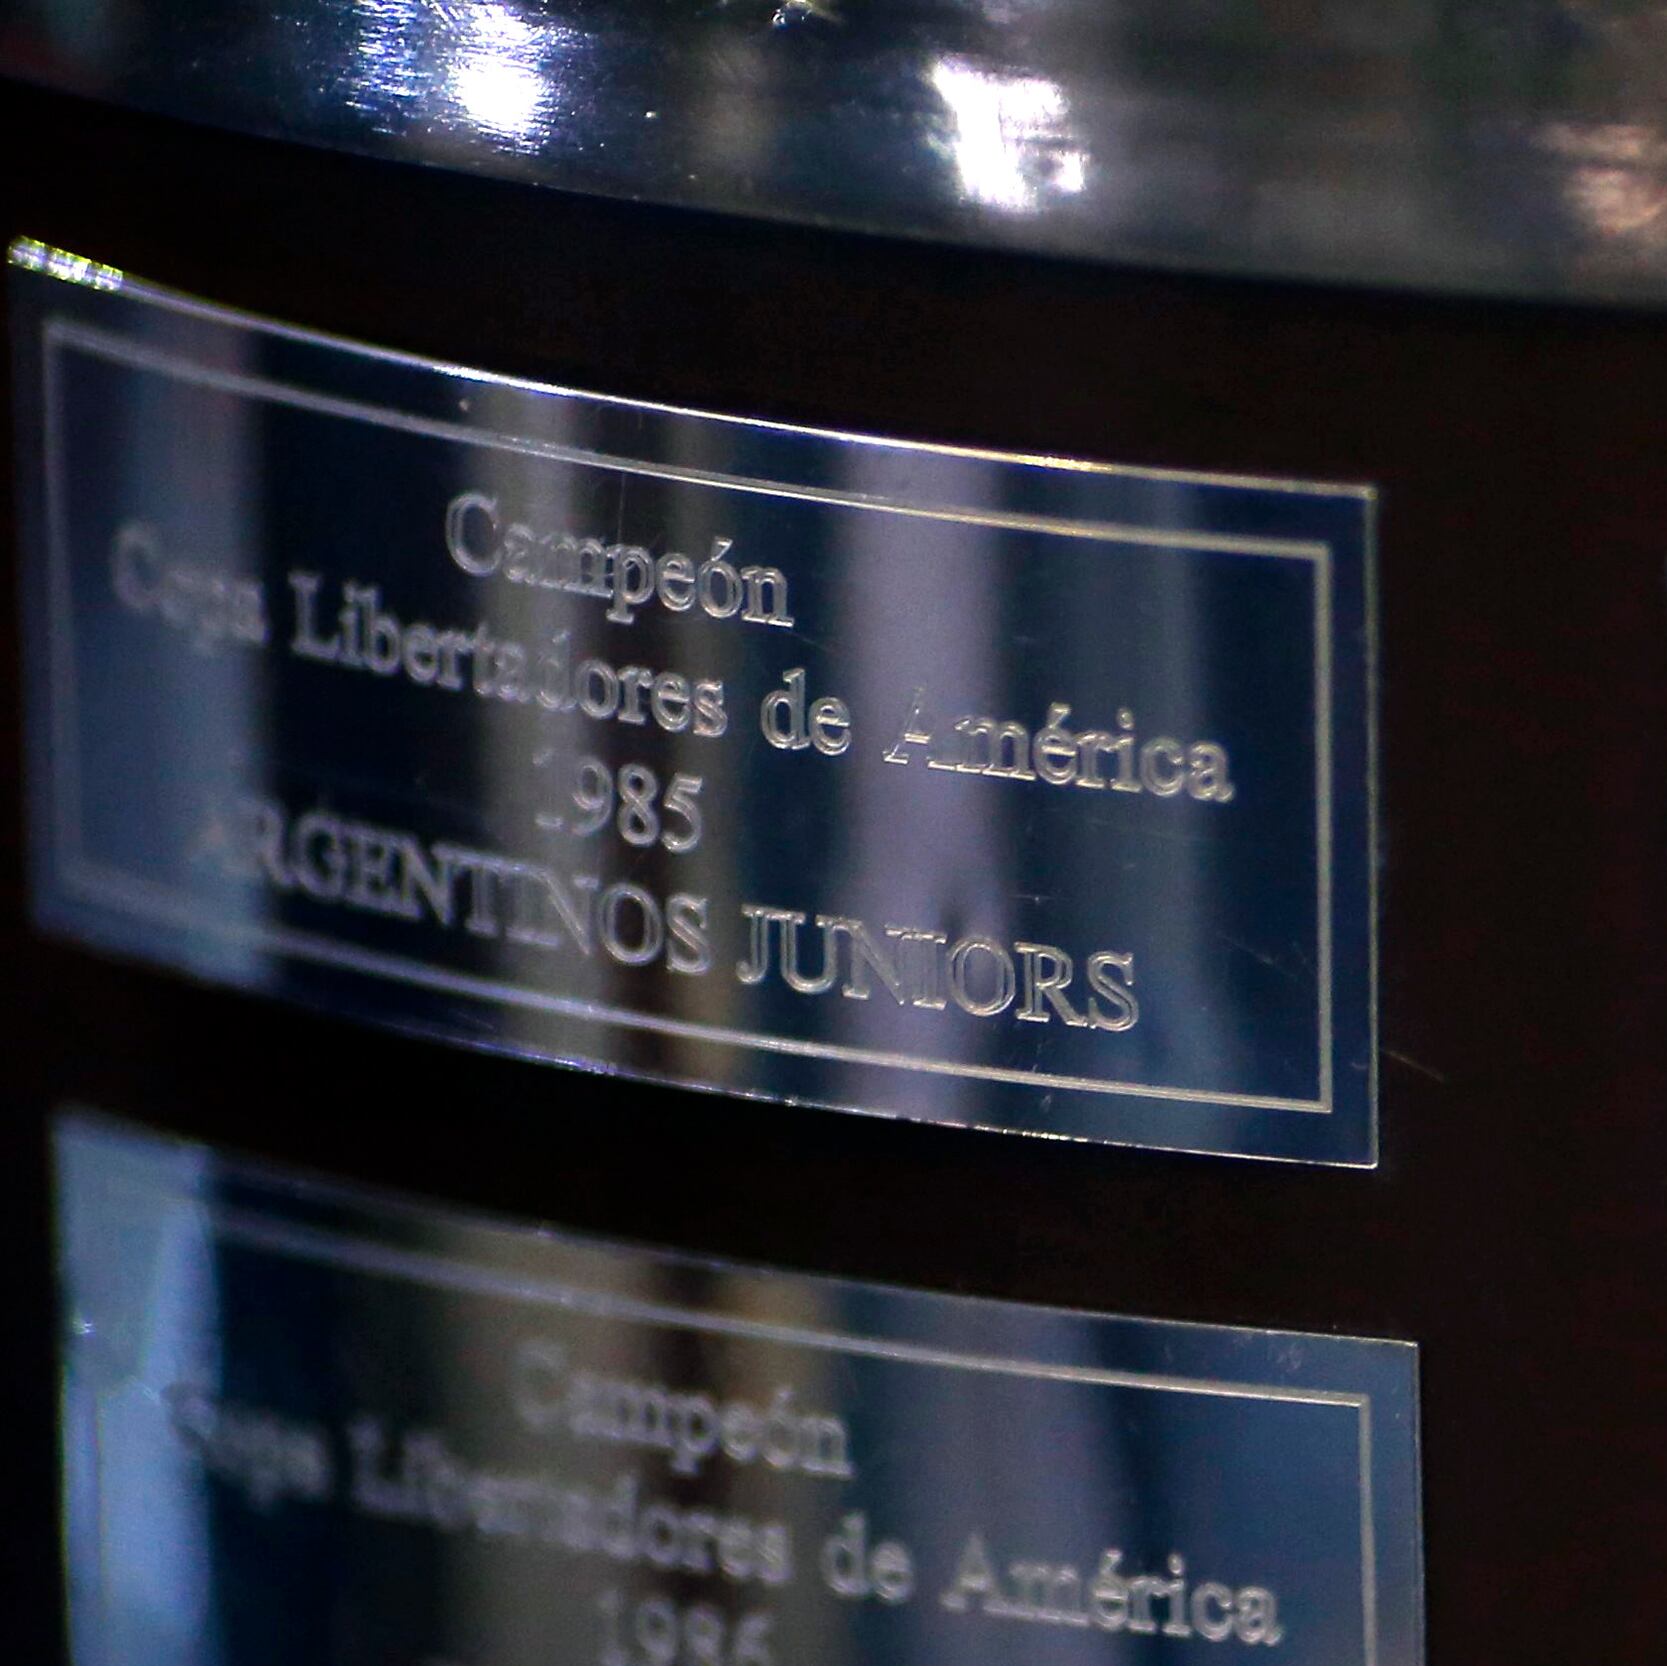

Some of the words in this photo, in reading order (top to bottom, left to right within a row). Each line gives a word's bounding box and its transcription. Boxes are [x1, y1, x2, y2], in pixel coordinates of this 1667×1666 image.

[447, 490, 793, 627] Campeón
[291, 573, 725, 738] Libertadores
[761, 668, 850, 757] de
[884, 687, 1232, 801] América
[536, 749, 705, 853] 1985
[737, 904, 1138, 1033] JUNIORS
[518, 1340, 851, 1476] Campeón
[820, 1510, 913, 1603] de
[942, 1533, 1283, 1646] América
